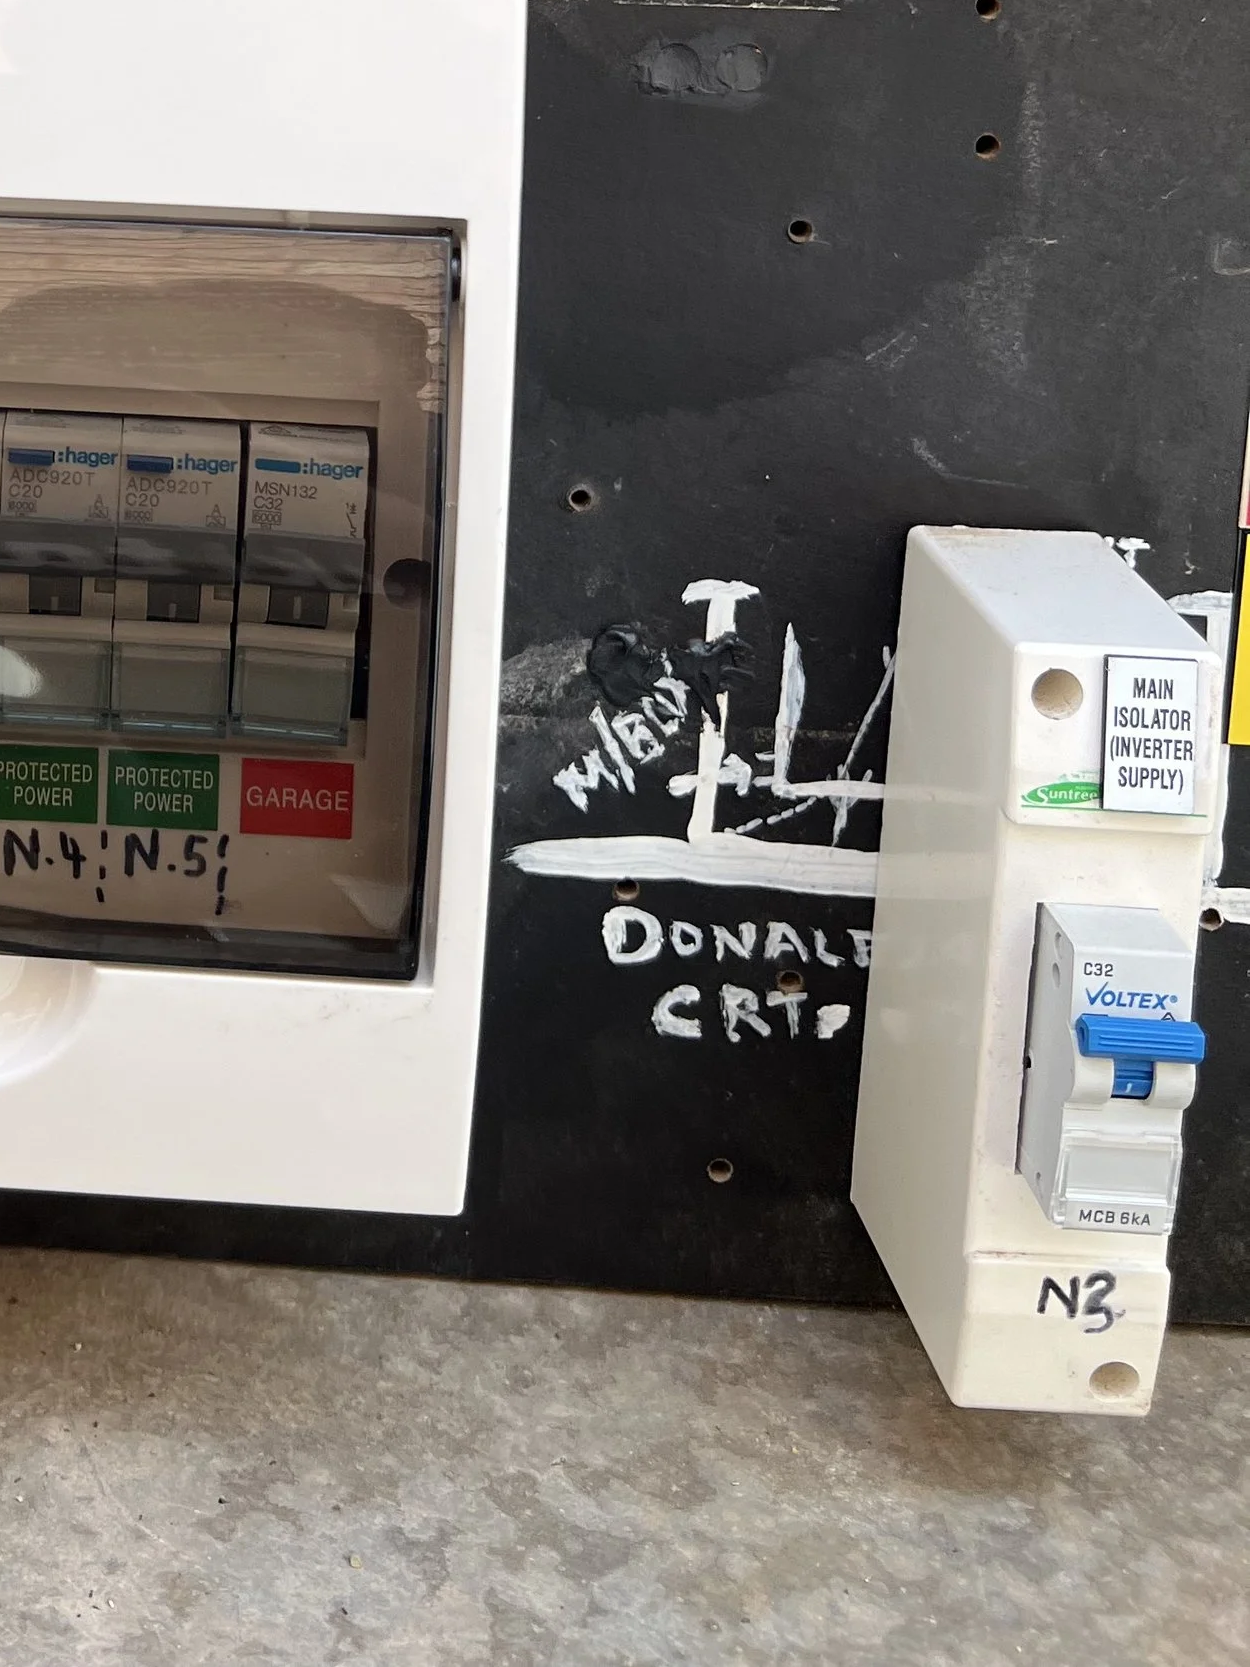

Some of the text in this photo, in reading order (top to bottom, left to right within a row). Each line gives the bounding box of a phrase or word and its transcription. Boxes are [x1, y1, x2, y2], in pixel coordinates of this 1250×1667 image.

[9, 468, 95, 486] ADC920T
[125, 477, 212, 495] ADC920T
[8, 484, 43, 498] C20
[125, 493, 160, 508] C20
[254, 482, 318, 500] MSN132
[253, 496, 283, 510] C32
[1132, 677, 1174, 700] MAIN
[1113, 705, 1191, 731] ISOLATOR
[1109, 736, 1194, 763] (INVERTER
[115, 766, 214, 789] PROTECTED
[1117, 766, 1184, 795] SUPPLY)
[13, 786, 74, 807] POWER
[134, 792, 193, 813] POWER
[246, 786, 350, 812] GARAGE
[1036, 787, 1098, 804] Suntree
[3, 828, 87, 879] N.4
[124, 828, 207, 877] N.5
[1083, 962, 1114, 977] C32
[1078, 1209, 1151, 1226] MCB 6kA
